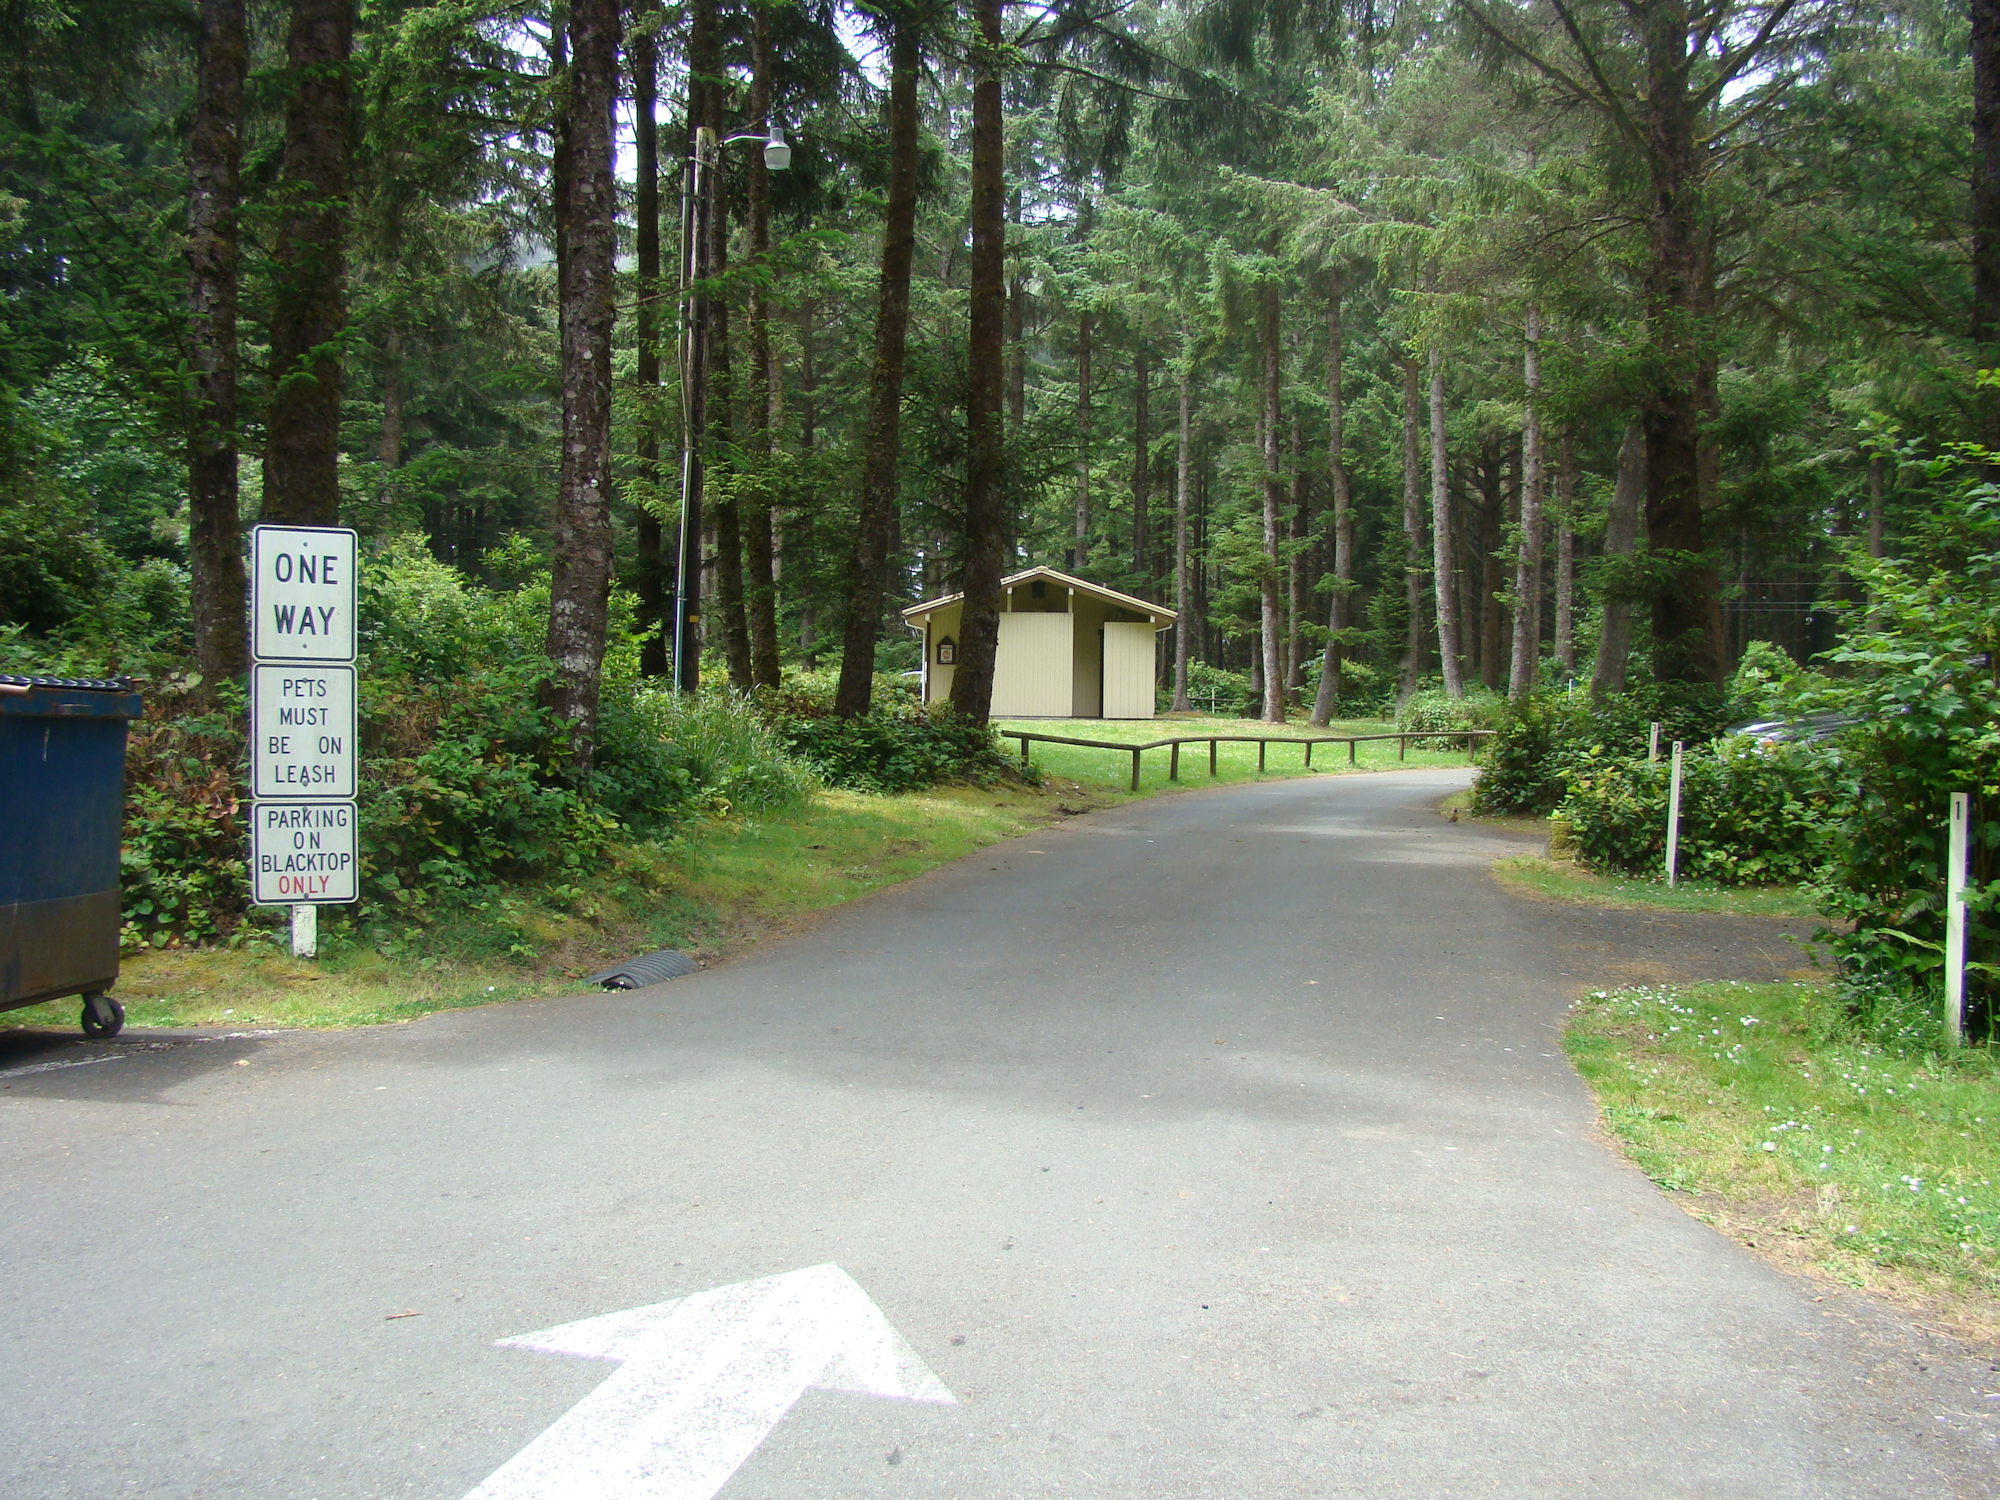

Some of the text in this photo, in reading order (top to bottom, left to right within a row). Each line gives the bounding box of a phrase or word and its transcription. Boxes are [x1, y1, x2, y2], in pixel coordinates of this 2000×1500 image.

[275, 553, 338, 585] ONE
[274, 604, 335, 635] WAY
[283, 679, 327, 697] PETS
[280, 708, 329, 726] MUST
[269, 736, 342, 755] BE ON
[1674, 743, 1681, 755] 2
[275, 765, 336, 784] LEASH
[268, 809, 348, 829] PARKING
[293, 831, 321, 850] ON
[262, 853, 351, 873] BLACKTOP
[278, 875, 330, 894] ONLY
